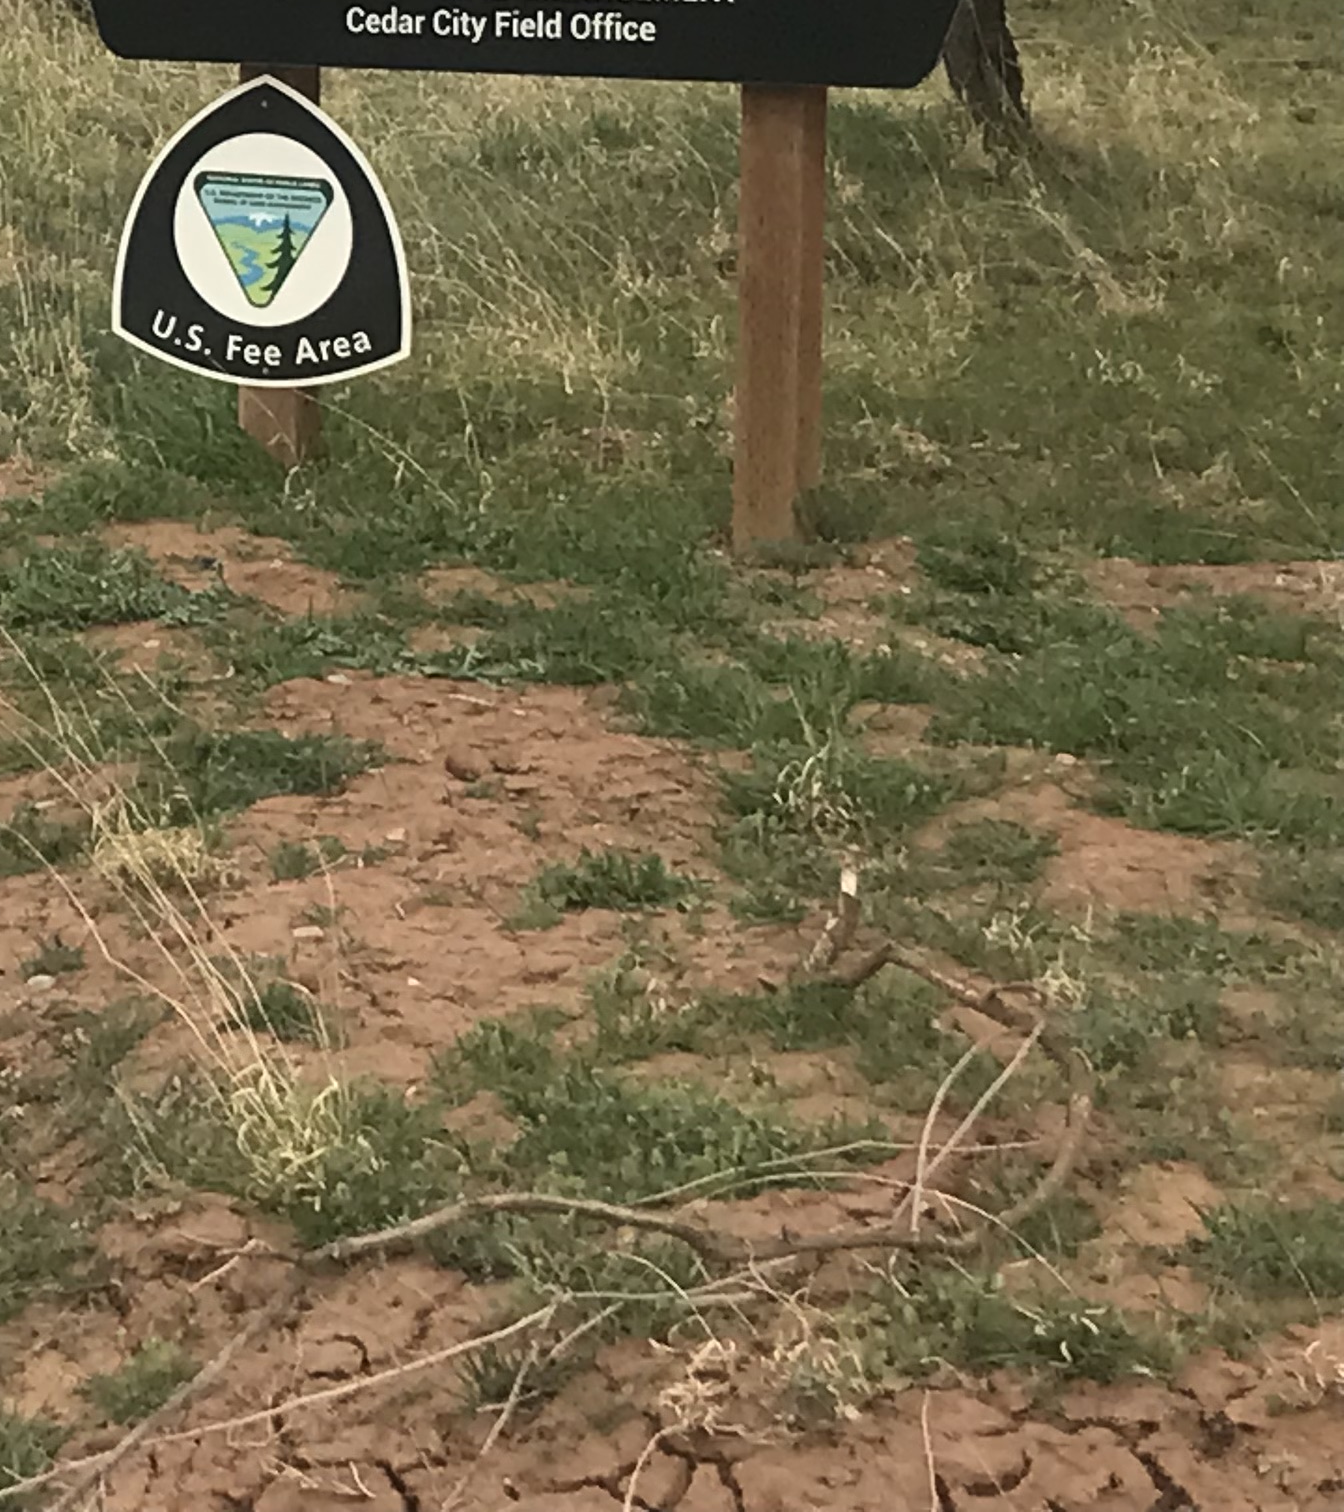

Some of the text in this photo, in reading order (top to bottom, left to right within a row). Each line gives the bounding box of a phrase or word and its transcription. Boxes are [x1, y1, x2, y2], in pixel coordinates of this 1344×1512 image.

[346, 5, 657, 44] Cedar City Field Office
[151, 309, 372, 366] U.S. Fee Area
